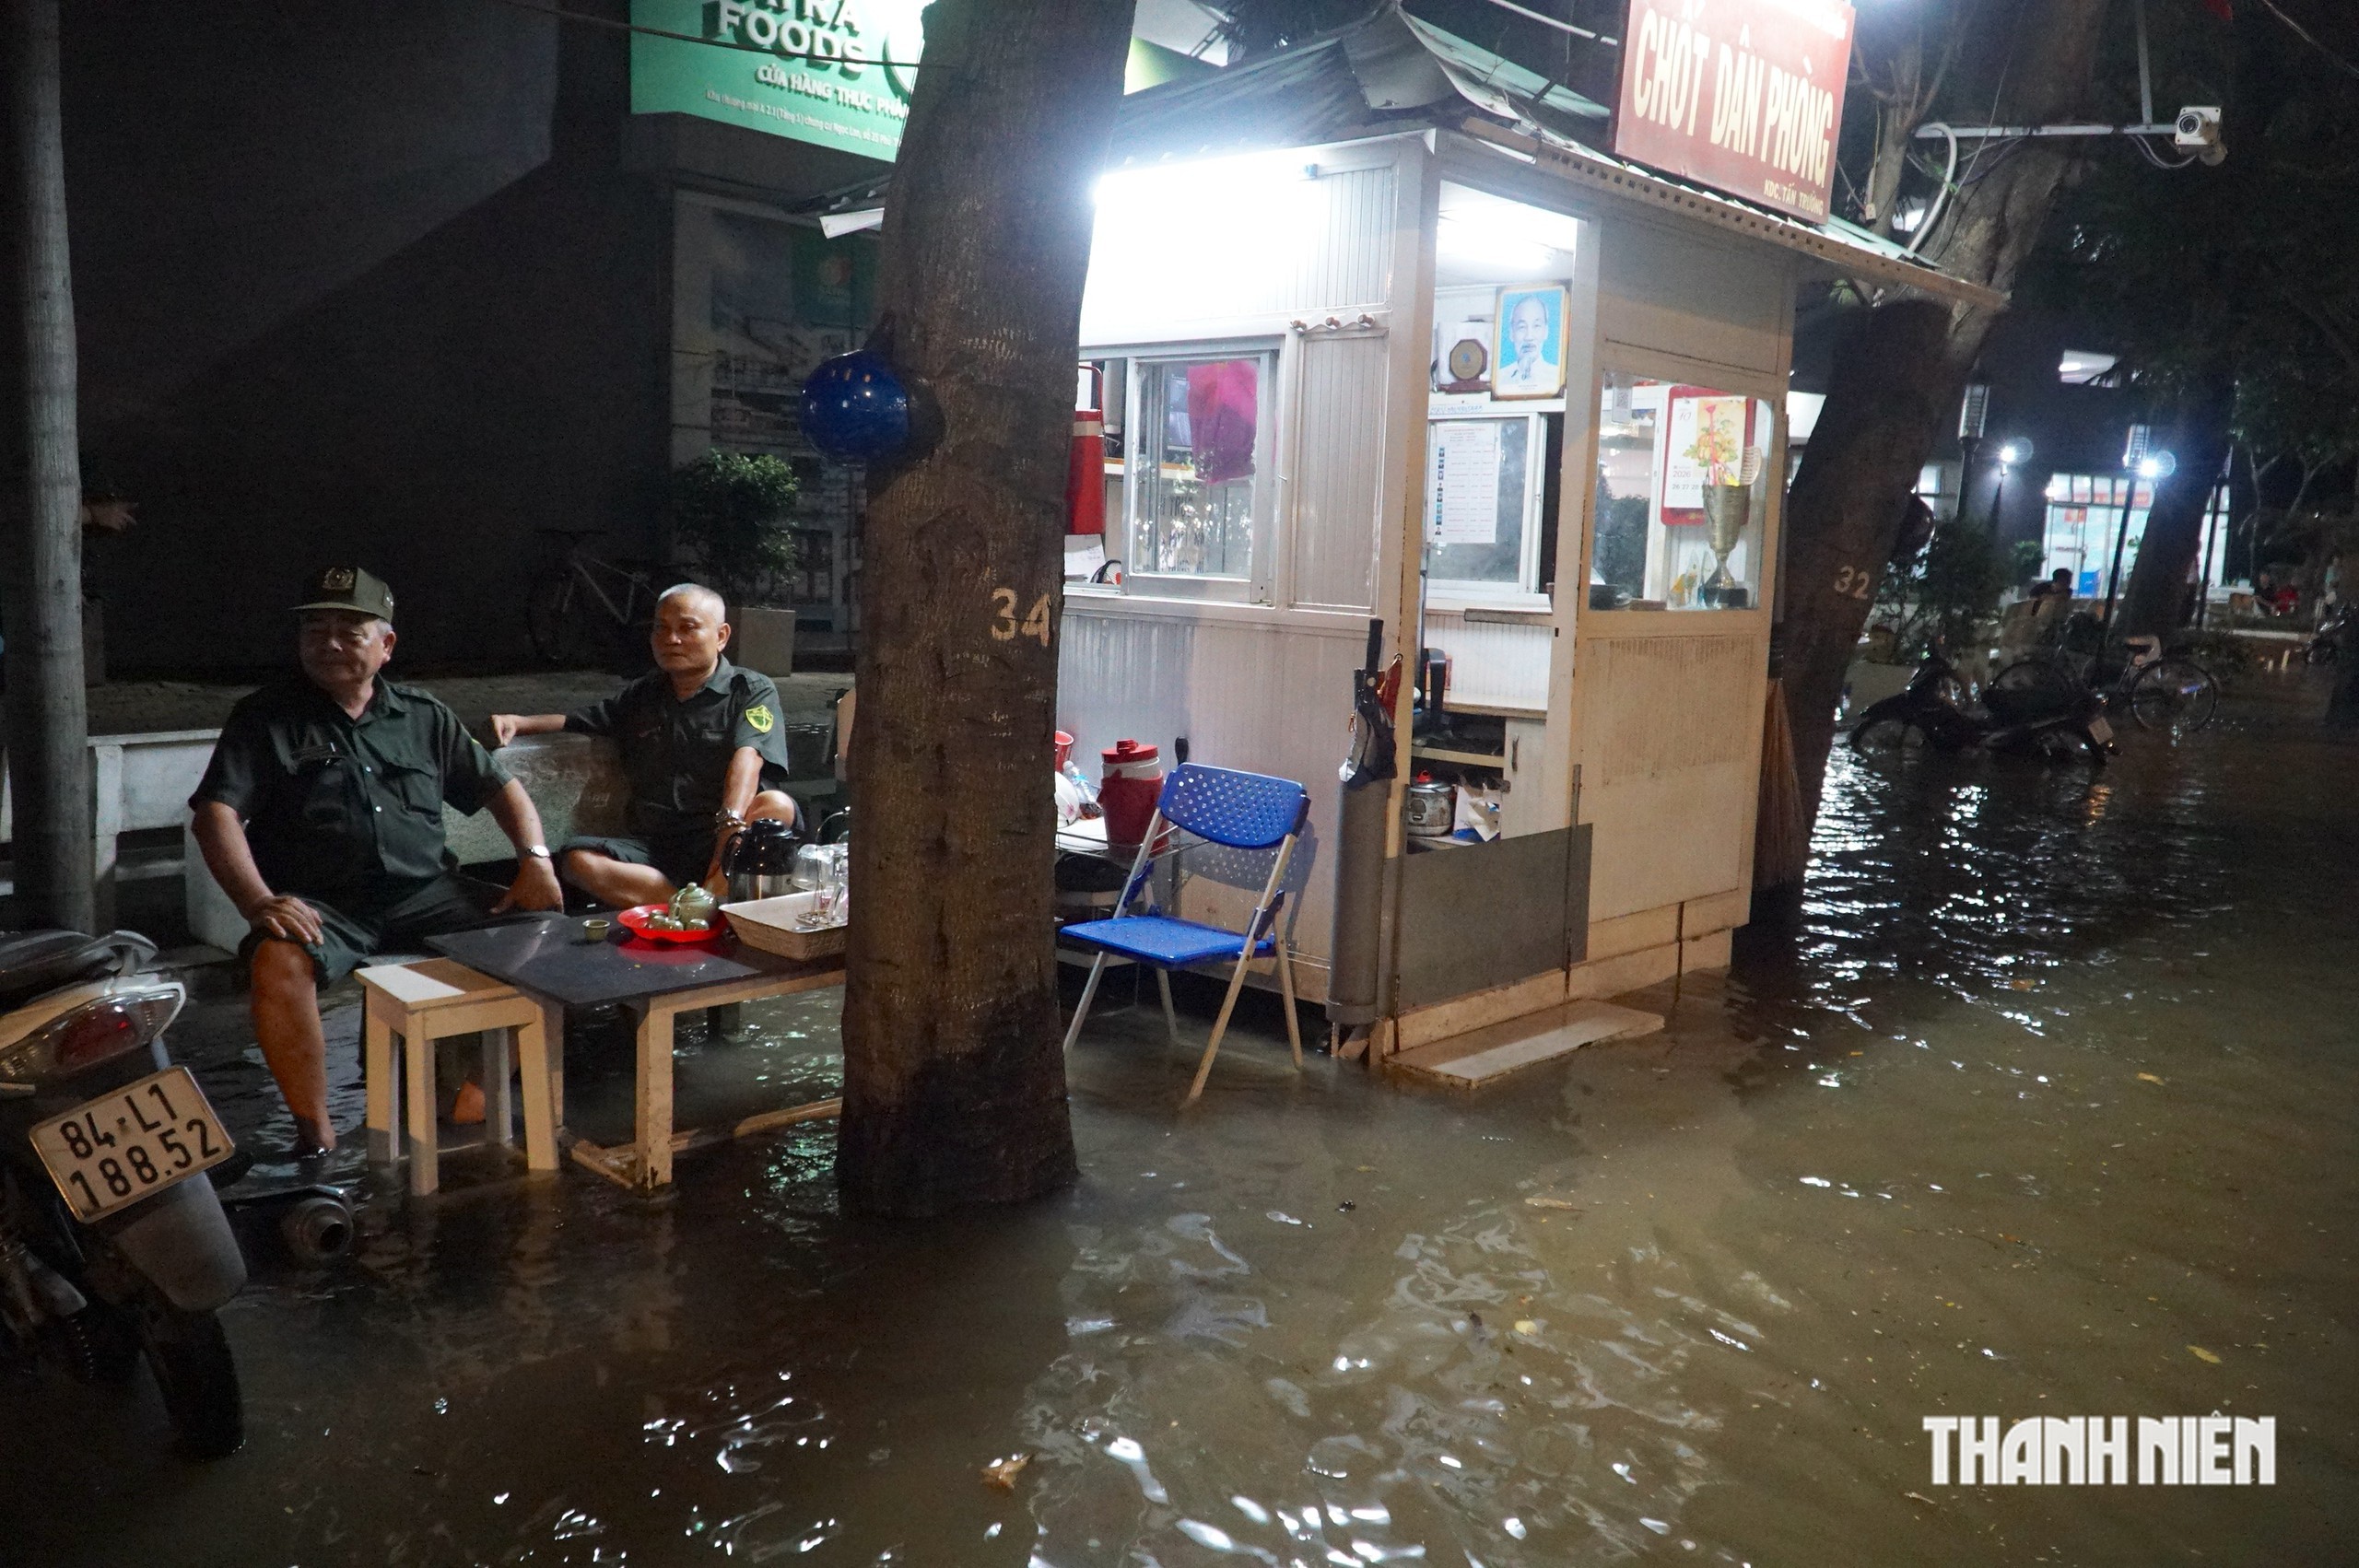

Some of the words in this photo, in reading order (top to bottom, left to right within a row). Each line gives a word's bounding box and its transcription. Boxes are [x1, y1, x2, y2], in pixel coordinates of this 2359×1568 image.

[719, 0, 868, 72] FOODS
[1634, 0, 1711, 136] CHỐT
[1710, 23, 1765, 157] DÂN
[1761, 55, 1834, 188] PHÒNG
[991, 587, 1051, 647] 34
[1835, 565, 1870, 600] 32
[69, 1118, 221, 1209] 188.52
